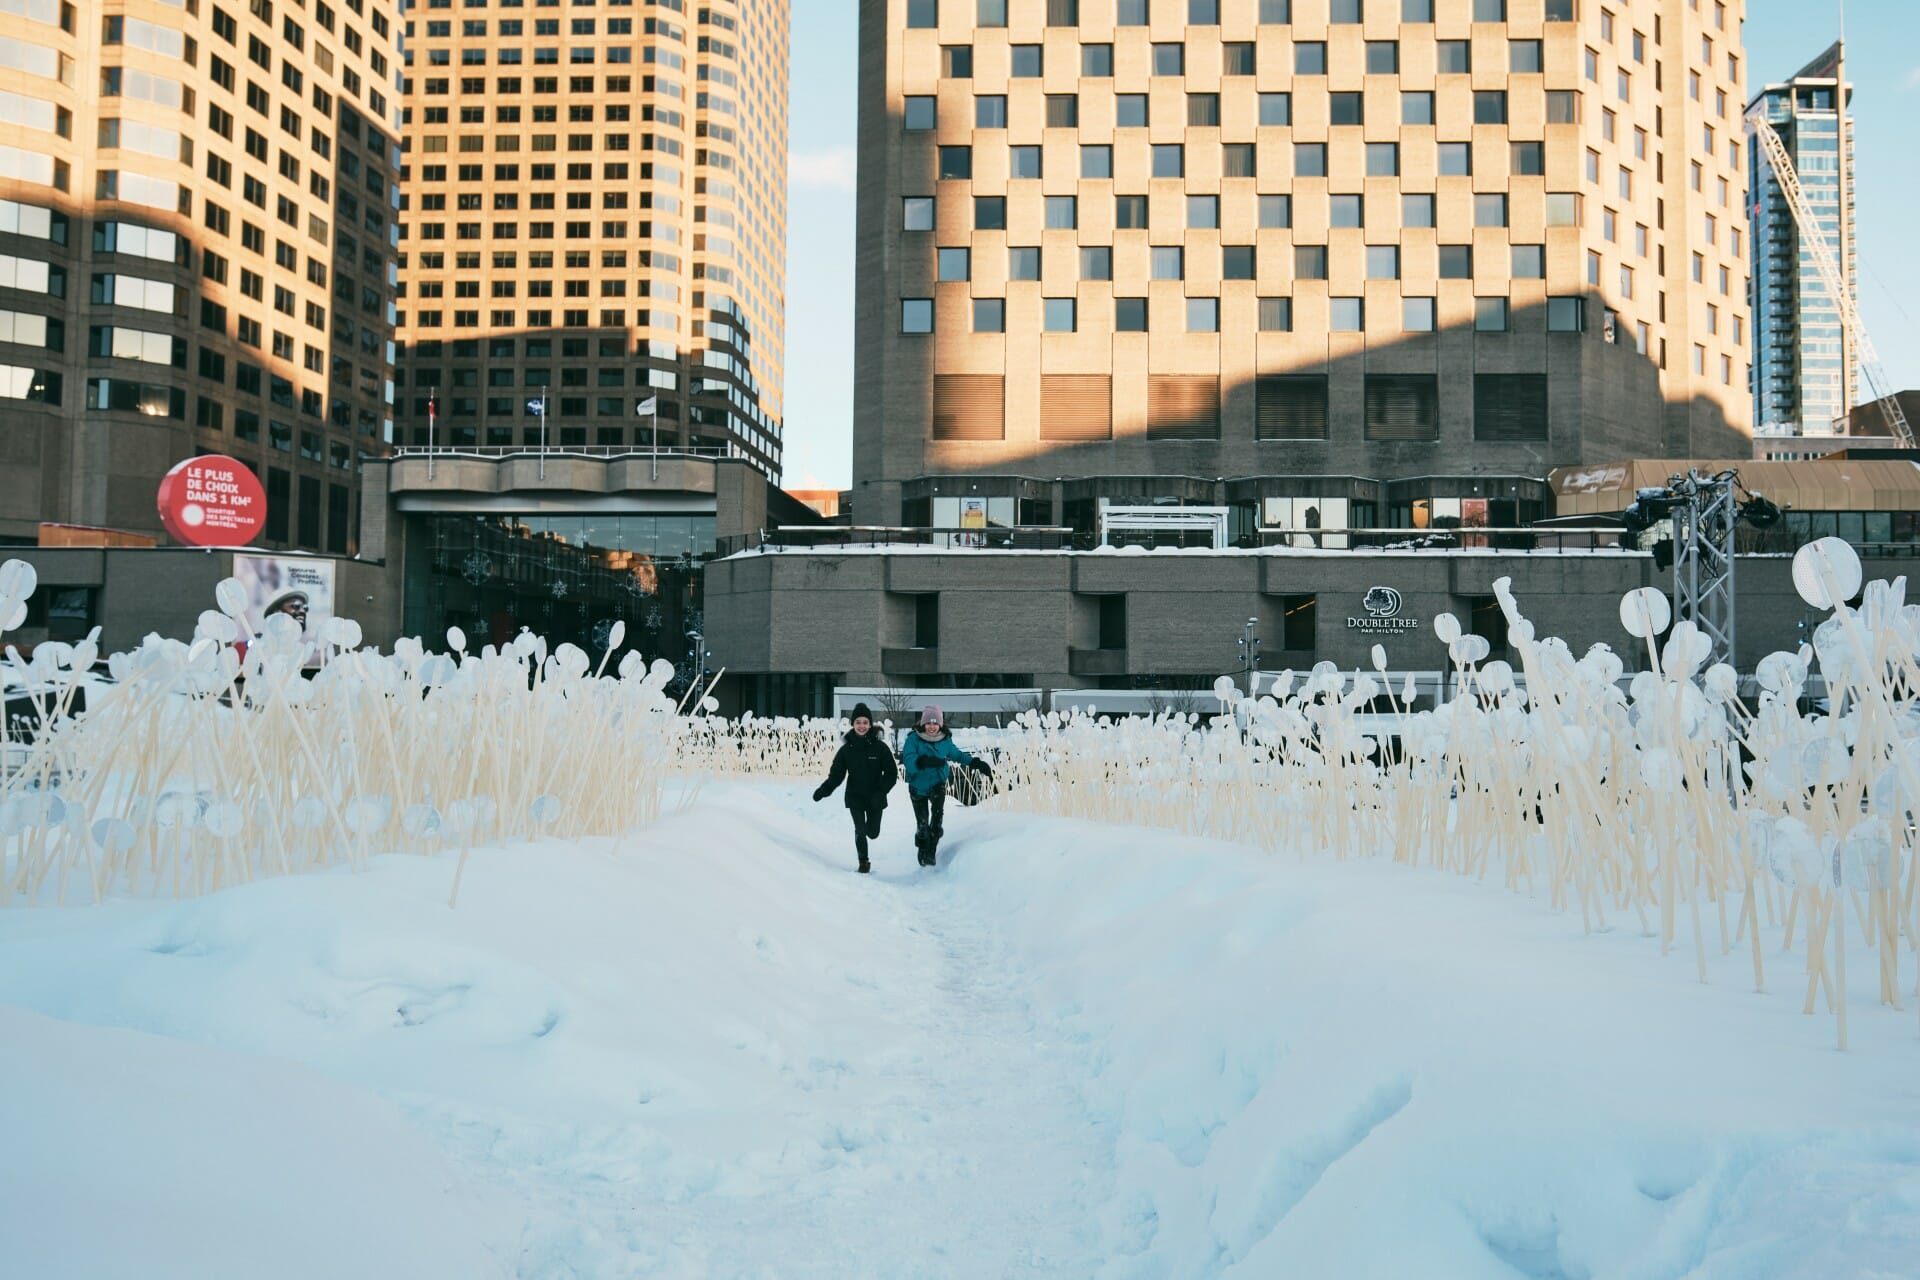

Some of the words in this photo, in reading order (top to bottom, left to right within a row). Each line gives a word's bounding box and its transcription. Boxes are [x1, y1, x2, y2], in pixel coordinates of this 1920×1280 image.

[187, 467, 202, 478] LE
[205, 469, 233, 482] PLUS
[187, 479, 202, 490] DE
[205, 481, 239, 494] CHOIX
[186, 490, 217, 503] DANS
[220, 494, 227, 504] 1
[206, 507, 236, 515] QUARTIER
[219, 515, 255, 524] SPECTACLES
